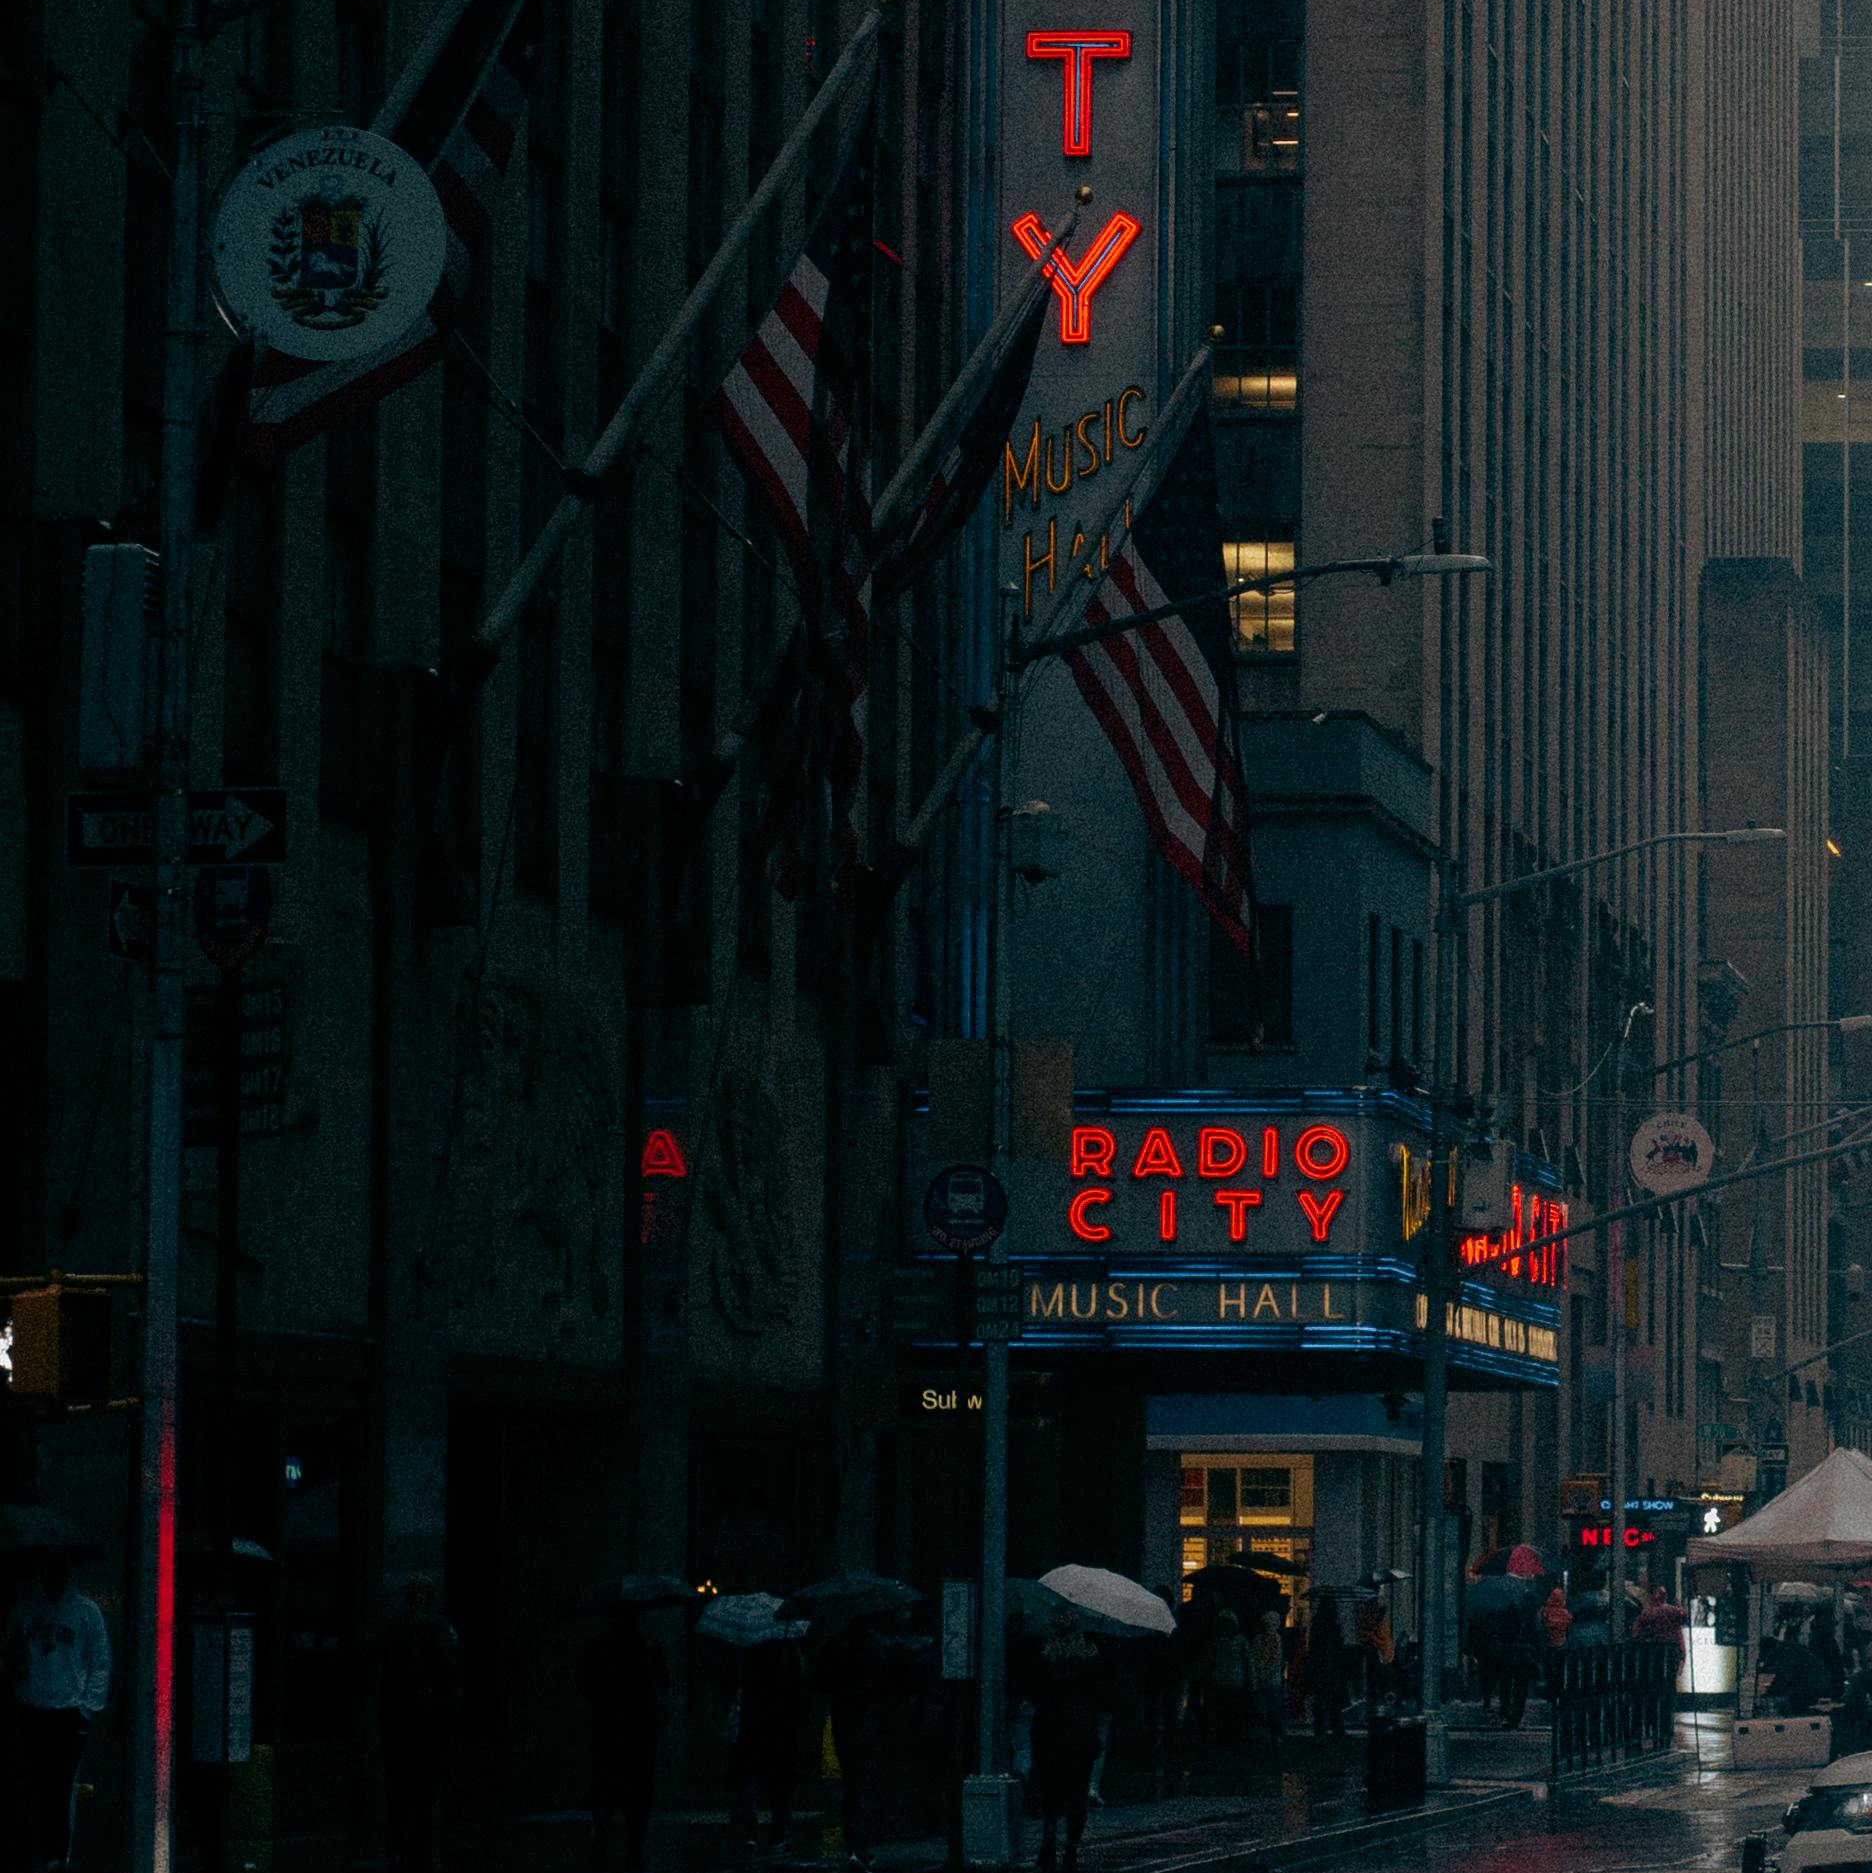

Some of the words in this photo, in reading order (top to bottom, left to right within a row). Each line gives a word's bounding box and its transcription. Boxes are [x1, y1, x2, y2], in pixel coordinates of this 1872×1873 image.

[256, 147, 398, 191] VENEZUELA
[1003, 384, 1147, 528] MUSIC
[191, 813, 253, 843] WAY
[1070, 1125, 1350, 1181] RADIO
[1067, 1186, 1345, 1244] CITY
[1030, 1281, 1180, 1319] MUSIC
[1218, 1281, 1346, 1320] HALL
